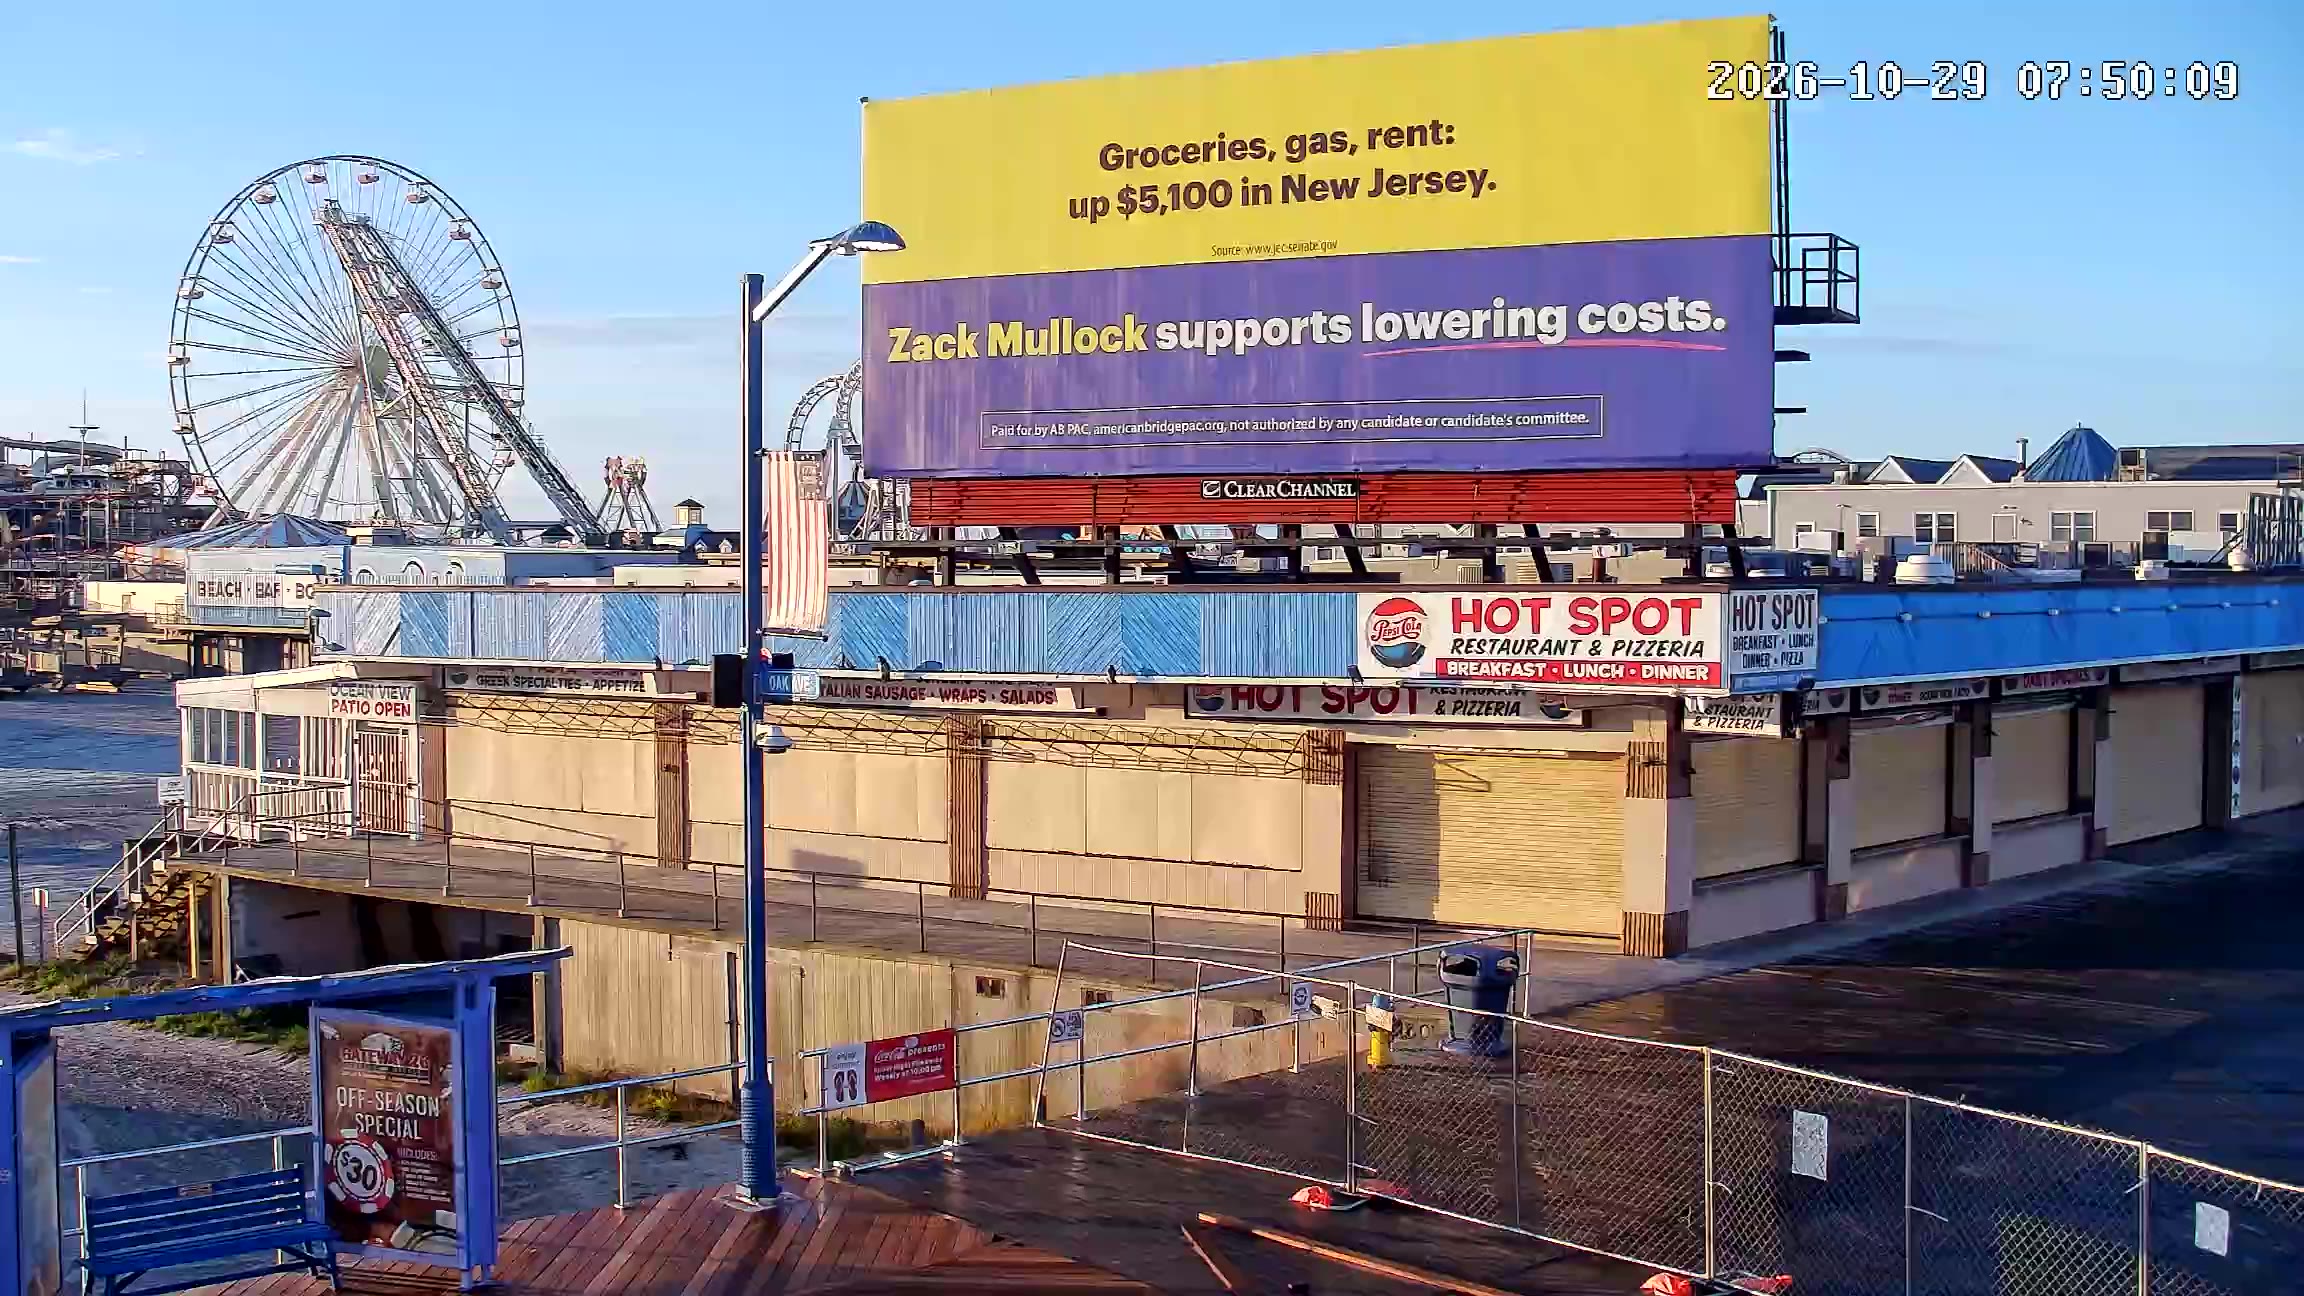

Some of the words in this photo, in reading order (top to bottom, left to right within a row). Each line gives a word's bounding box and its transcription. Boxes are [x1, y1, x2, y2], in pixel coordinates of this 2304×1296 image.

[1099, 132, 1277, 172] Groceries,
[1285, 127, 1358, 164] gas,
[1367, 119, 1455, 151] rent:
[1069, 193, 1110, 225] up
[1116, 177, 1233, 221] $5,100
[1240, 176, 1272, 208] in
[1281, 172, 1359, 205] New
[1368, 166, 1497, 200] Jersey.
[887, 322, 980, 363] Zack
[987, 313, 1149, 359] Mullock
[1155, 309, 1352, 356] supports
[1361, 295, 1569, 346] lowering
[1577, 295, 1728, 335] costs.
[991, 424, 1014, 438] Paid
[1015, 424, 1032, 437] for
[1034, 424, 1049, 440] by
[1050, 423, 1065, 436] AB
[1229, 419, 1250, 432] not
[1251, 416, 1316, 433] authorized
[1318, 415, 1334, 434] by
[1336, 417, 1358, 433] any
[1360, 414, 1423, 429] candidate
[1425, 416, 1438, 428] or
[1440, 411, 1513, 428] candidate's
[1515, 410, 1590, 427] committee.
[198, 581, 242, 598] BEACH
[1451, 597, 1551, 635] HOT
[1568, 596, 1703, 636] SPOT
[1732, 594, 1767, 632] HOT
[1771, 593, 1817, 631] SPOT
[1450, 638, 1582, 657] RESTAURANT
[1588, 639, 1602, 656] &
[1611, 639, 1705, 658] PIZZERIA
[1733, 634, 1778, 651] BREAKFAST
[1788, 633, 1814, 649] LUNCH
[1743, 652, 1770, 668] DINNER
[1781, 651, 1804, 666] PIZZA
[1447, 660, 1547, 678] BREAKFAST
[1563, 663, 1626, 679] LUNCH
[1641, 664, 1709, 681] DINNER
[331, 683, 374, 699] OCEAN
[378, 685, 412, 700] VIEW
[477, 674, 510, 688] GREEK
[514, 675, 582, 690] SPECIALTIES
[769, 675, 789, 692] OAK
[820, 683, 860, 699] TALIAN
[865, 685, 926, 701] SAUSAGE
[939, 686, 987, 704] WRAPS
[1000, 688, 1056, 706] SALADS
[331, 698, 371, 715] PATIO
[374, 701, 411, 717] OPEN
[1434, 700, 1446, 716] &
[1451, 699, 1522, 717] PIZZERIA
[1692, 715, 1702, 727] &
[1707, 716, 1765, 731] PIZZERIA
[336, 1086, 441, 1118] OFF-SEASON
[355, 1112, 423, 1140] SPECIAL
[340, 1150, 377, 1192] $30
